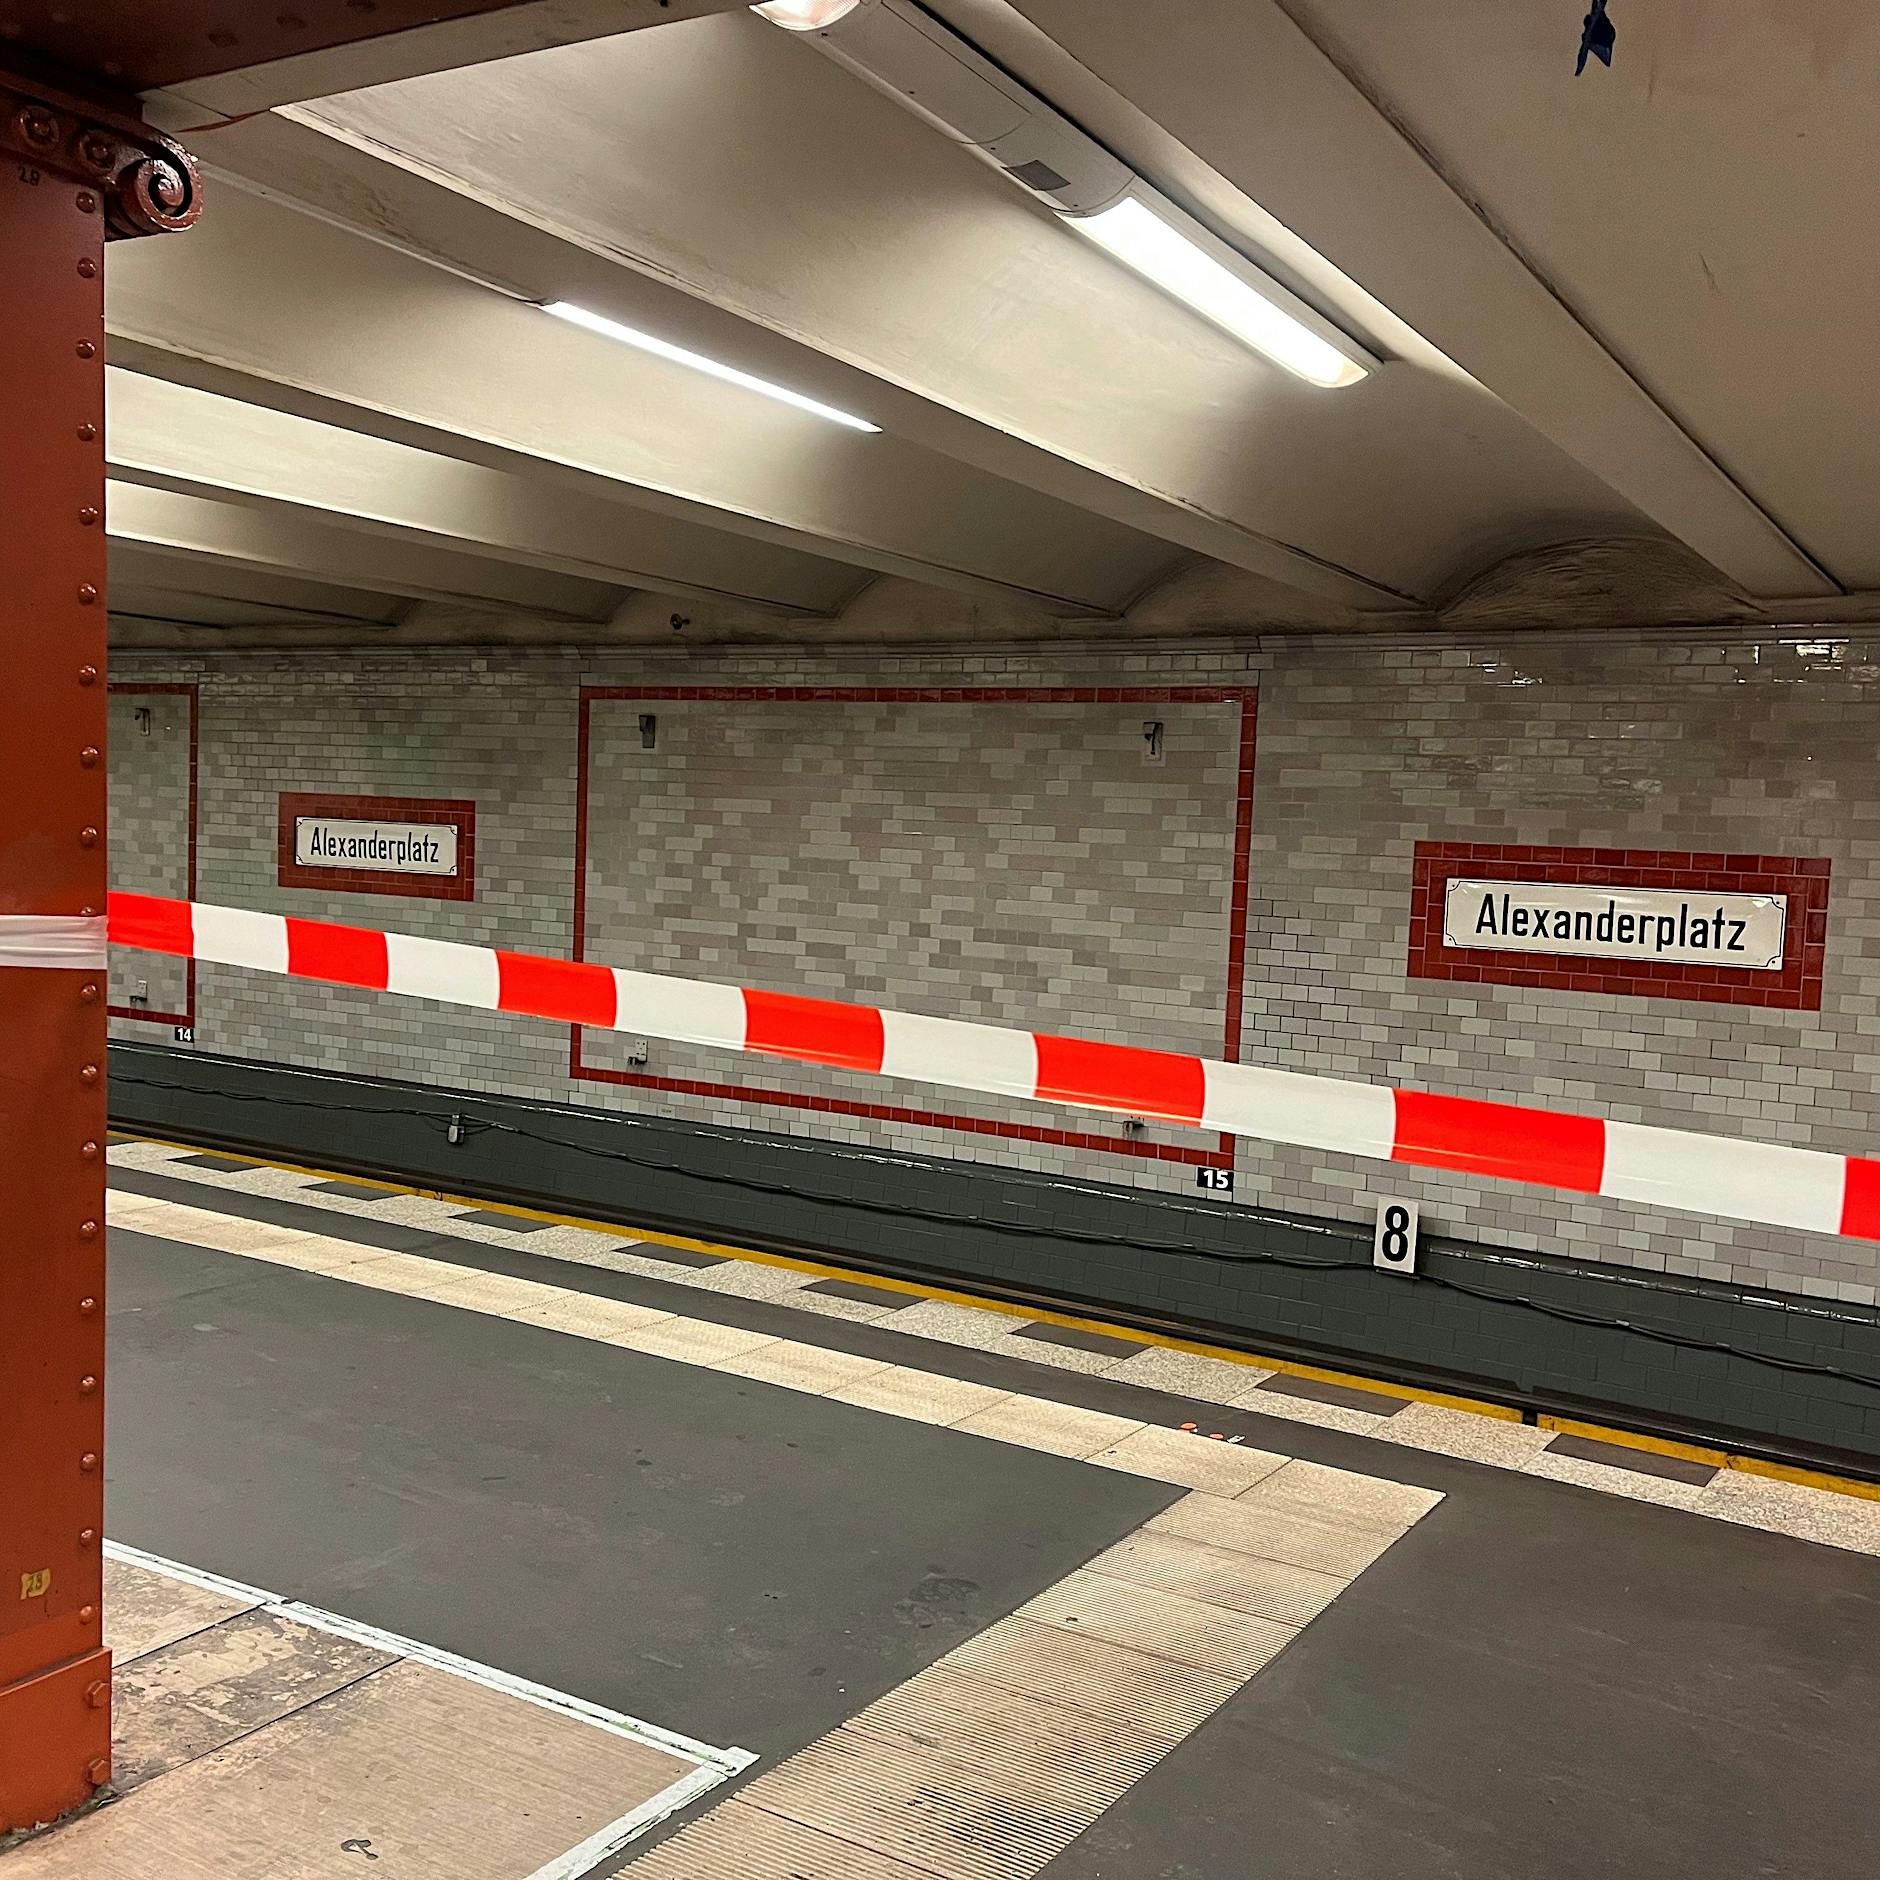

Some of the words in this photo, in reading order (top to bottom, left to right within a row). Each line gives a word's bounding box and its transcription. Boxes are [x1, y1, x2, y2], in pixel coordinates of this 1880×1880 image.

[310, 826, 439, 864] Alexanderplatz
[1475, 893, 1747, 952] Alexanderplatz
[177, 1027, 192, 1042] 14
[1203, 1169, 1229, 1189] 15
[1381, 1205, 1410, 1262] 8
